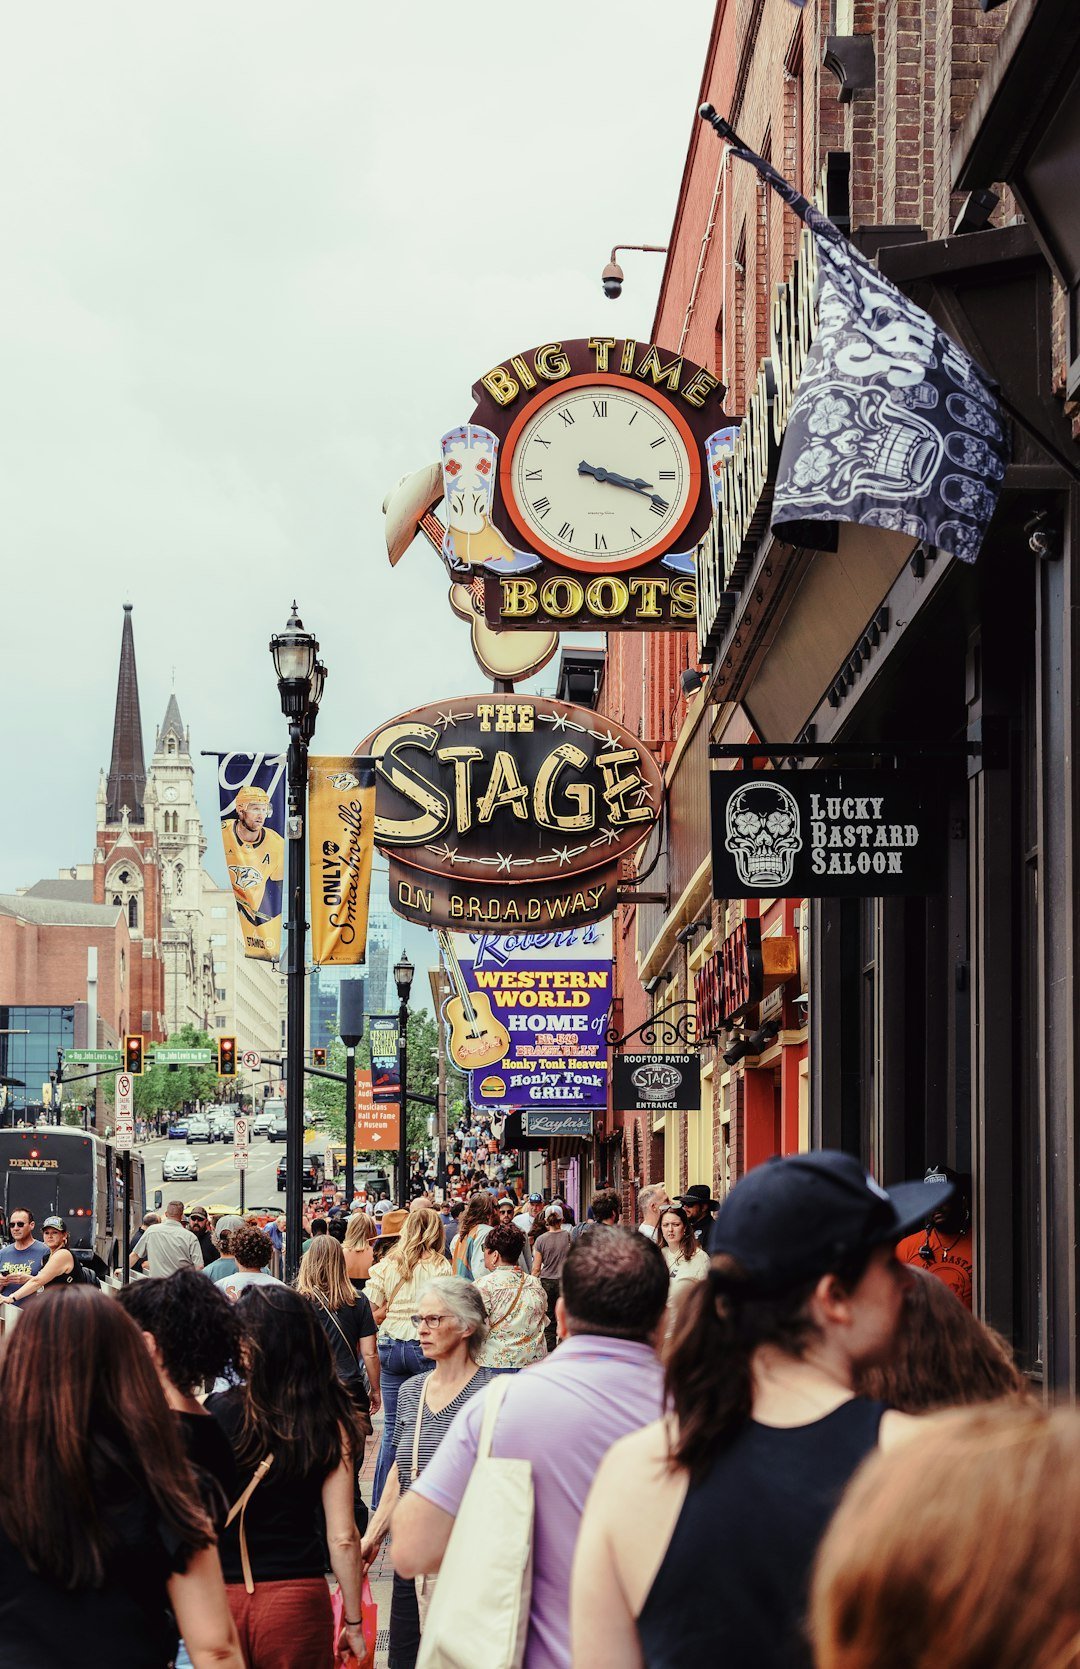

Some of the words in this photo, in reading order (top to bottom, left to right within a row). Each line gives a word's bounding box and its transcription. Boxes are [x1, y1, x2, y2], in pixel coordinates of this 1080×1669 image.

[481, 342, 571, 406] BIG
[588, 336, 720, 408] TIME
[592, 401, 608, 418] XII
[499, 576, 698, 619] BOOTS
[476, 703, 535, 733] THE
[372, 722, 654, 845] STAGE
[810, 793, 884, 820] LUCKY
[810, 822, 919, 847] BASTARD
[329, 799, 362, 945] Smashville
[811, 848, 903, 875] SALOON
[323, 858, 342, 907] ONLY
[398, 881, 433, 913] ON
[450, 885, 607, 921] BROADWAY
[474, 971, 609, 989] WESTERN
[493, 990, 590, 1008] WORLD
[508, 1014, 588, 1031] HOME
[591, 1013, 607, 1035] of
[502, 1058, 537, 1072] Honky
[539, 1058, 566, 1070] Tonk
[568, 1058, 608, 1070] Heaven
[624, 1055, 663, 1063] ROOFTOP
[665, 1055, 690, 1063] PATIO
[510, 1072, 561, 1088] Honky
[563, 1071, 602, 1087] Tonk
[634, 1069, 679, 1086] STAGE
[529, 1087, 584, 1100] GRILL
[530, 1117, 588, 1133] Layla's
[9, 1159, 58, 1168] DENVER
